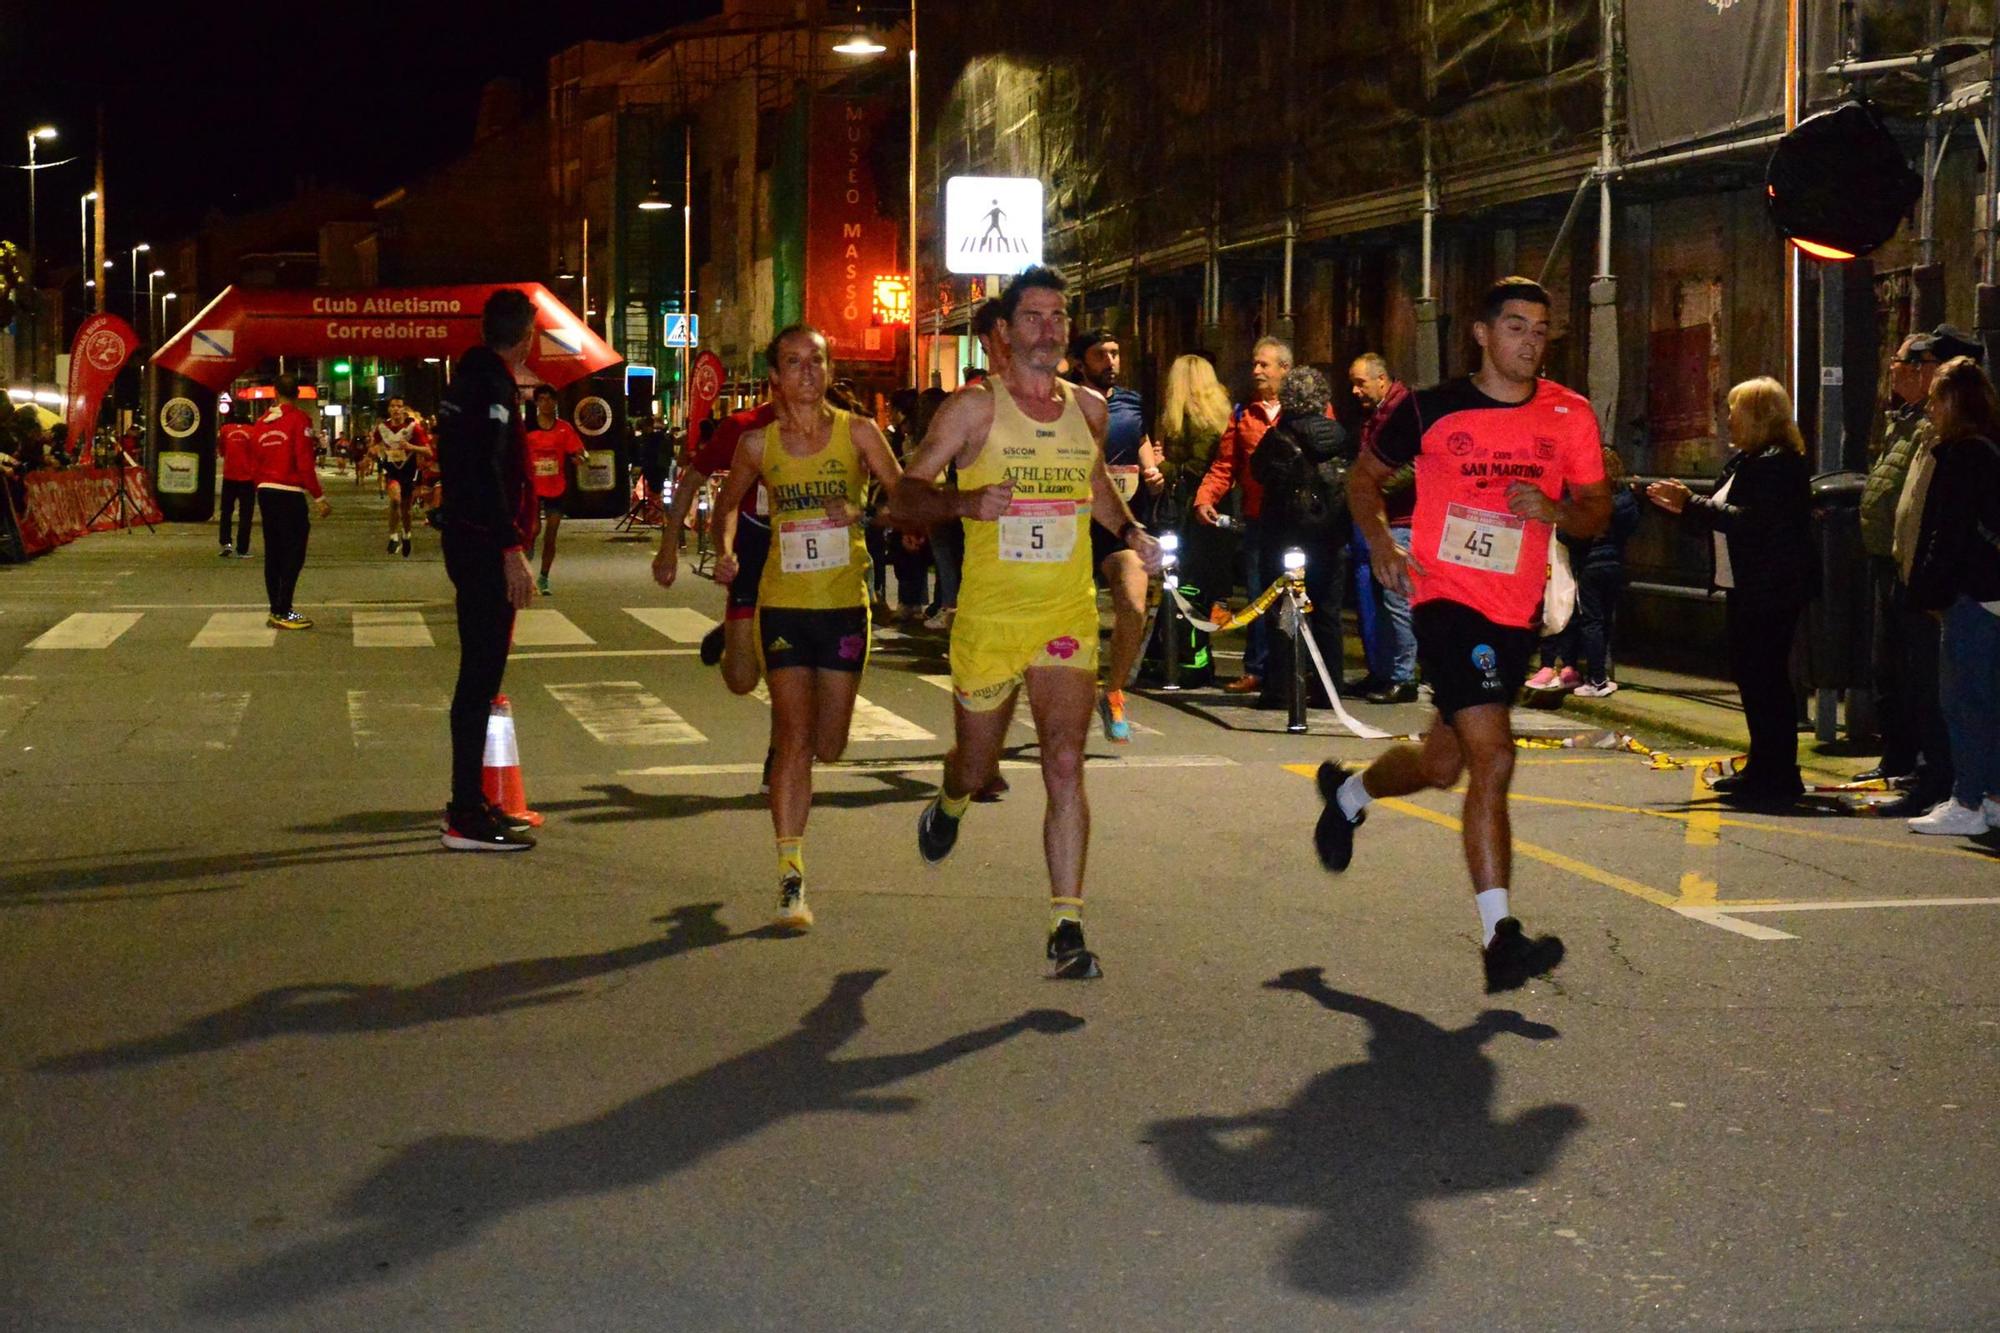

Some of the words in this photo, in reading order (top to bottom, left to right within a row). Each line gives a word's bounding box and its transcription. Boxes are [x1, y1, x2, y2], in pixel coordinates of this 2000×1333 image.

[845, 106, 862, 205] MUSEO
[312, 297, 358, 313] Club
[362, 297, 461, 313] Atletismo
[326, 322, 448, 338] Corredoiras
[1002, 466, 1087, 481] ATHLETICS
[1460, 462, 1488, 476] SAN
[1031, 525, 1044, 549] 5
[1464, 530, 1494, 558] 45
[806, 538, 818, 560] 6
